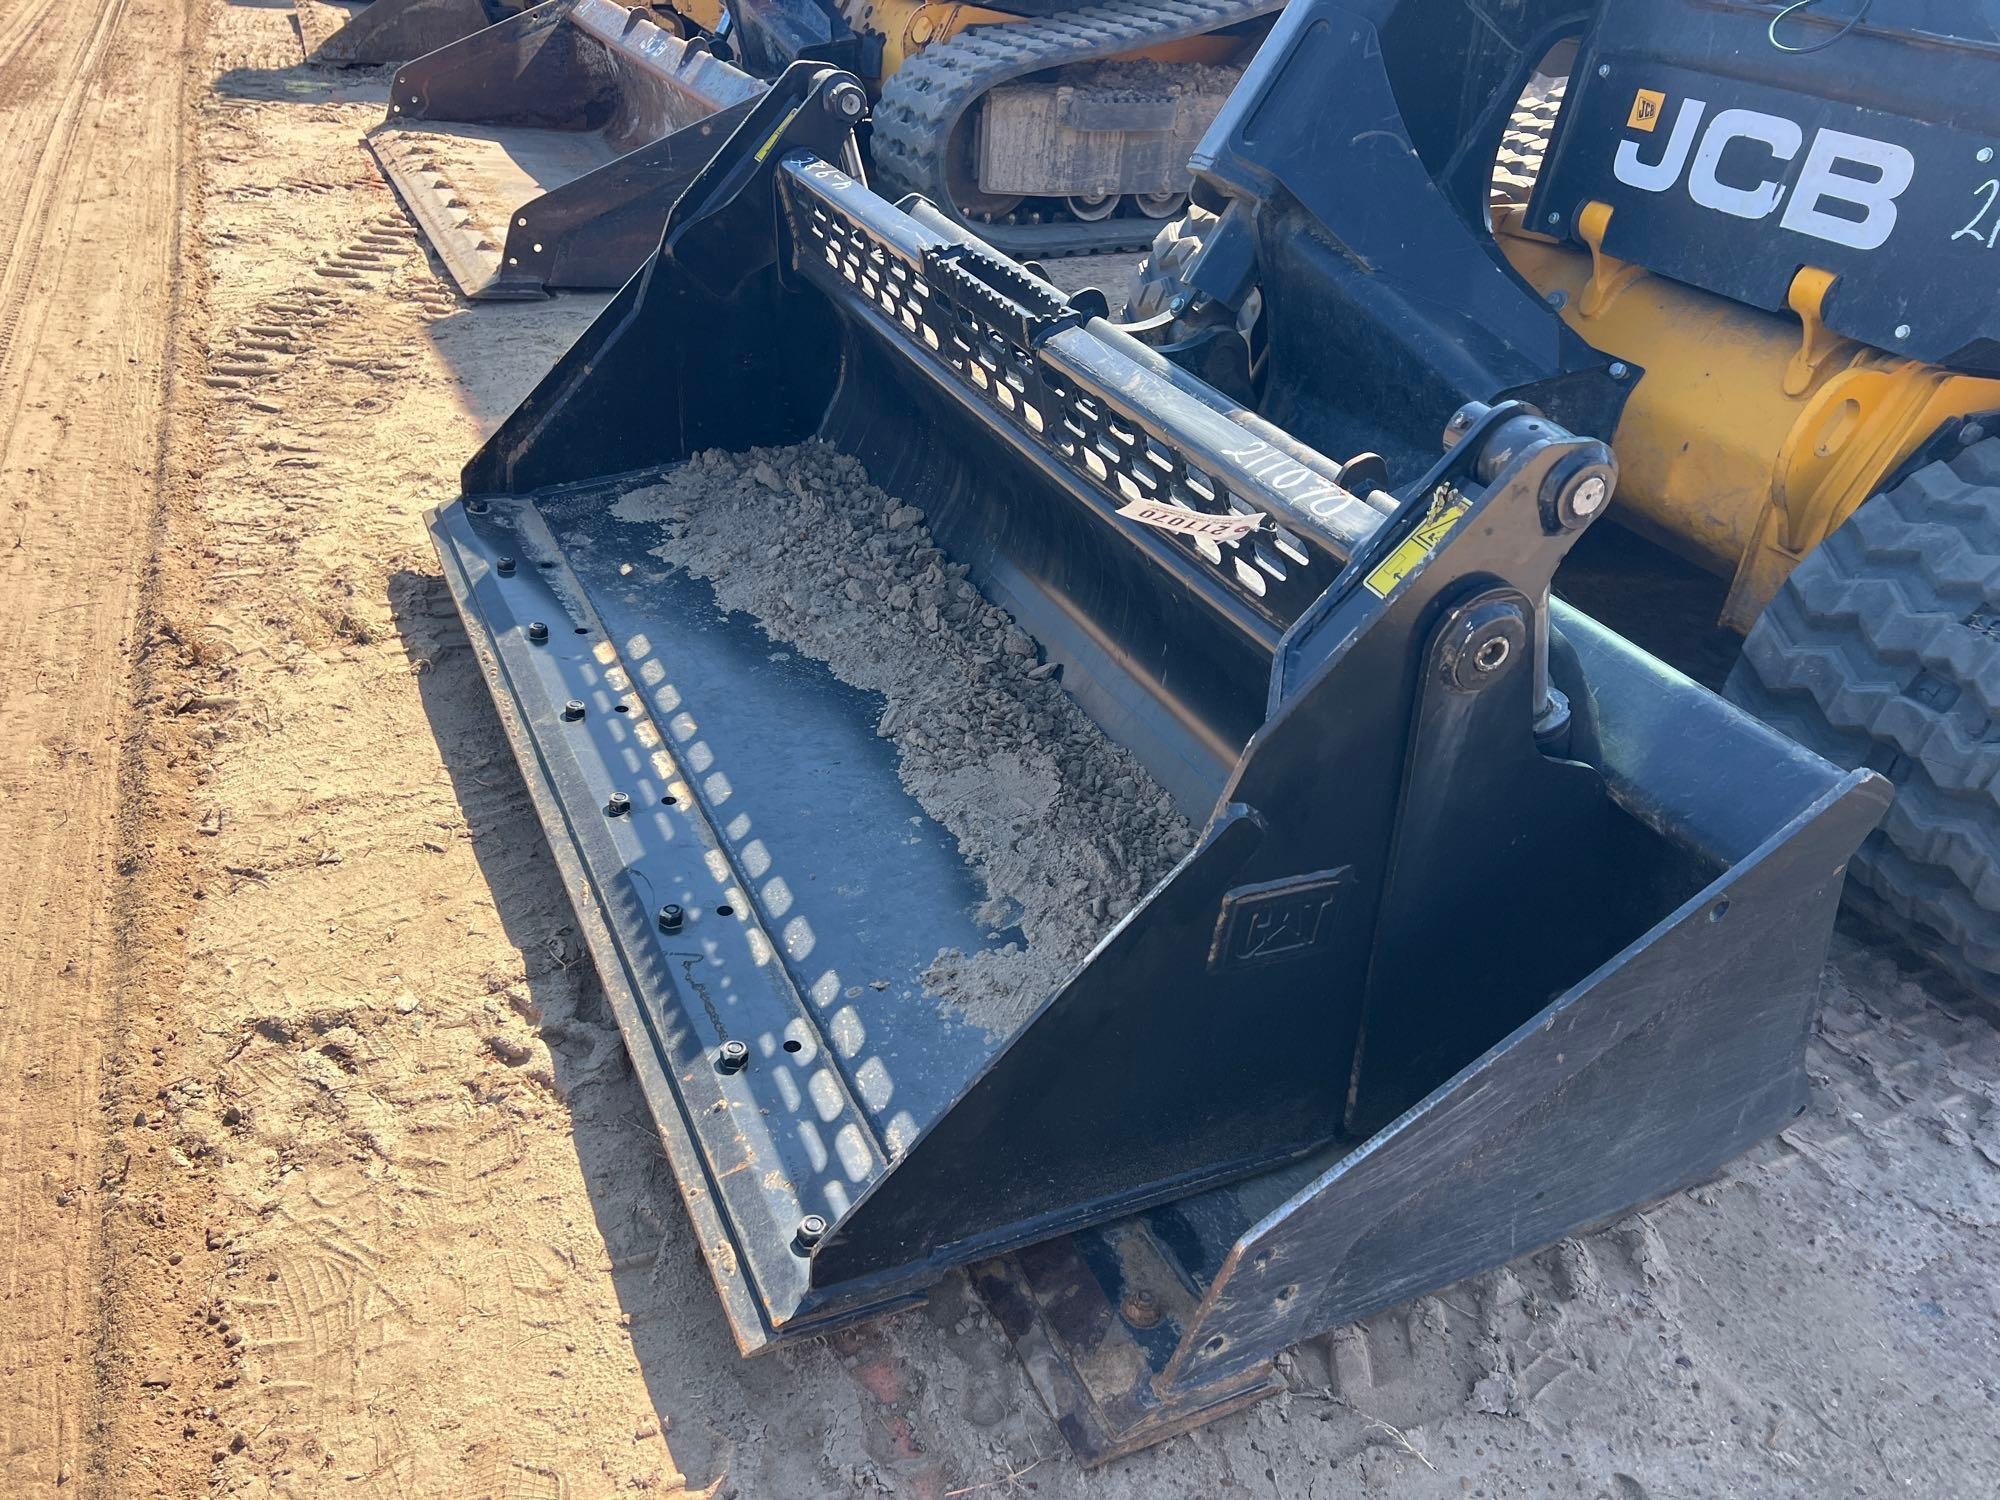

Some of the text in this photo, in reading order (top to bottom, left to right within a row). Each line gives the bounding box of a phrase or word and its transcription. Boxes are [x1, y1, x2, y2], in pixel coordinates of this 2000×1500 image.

[1638, 95, 1655, 118] JCB
[1613, 98, 1914, 250] JCB
[1220, 442, 1351, 516] 211070
[1139, 510, 1231, 536] 211070
